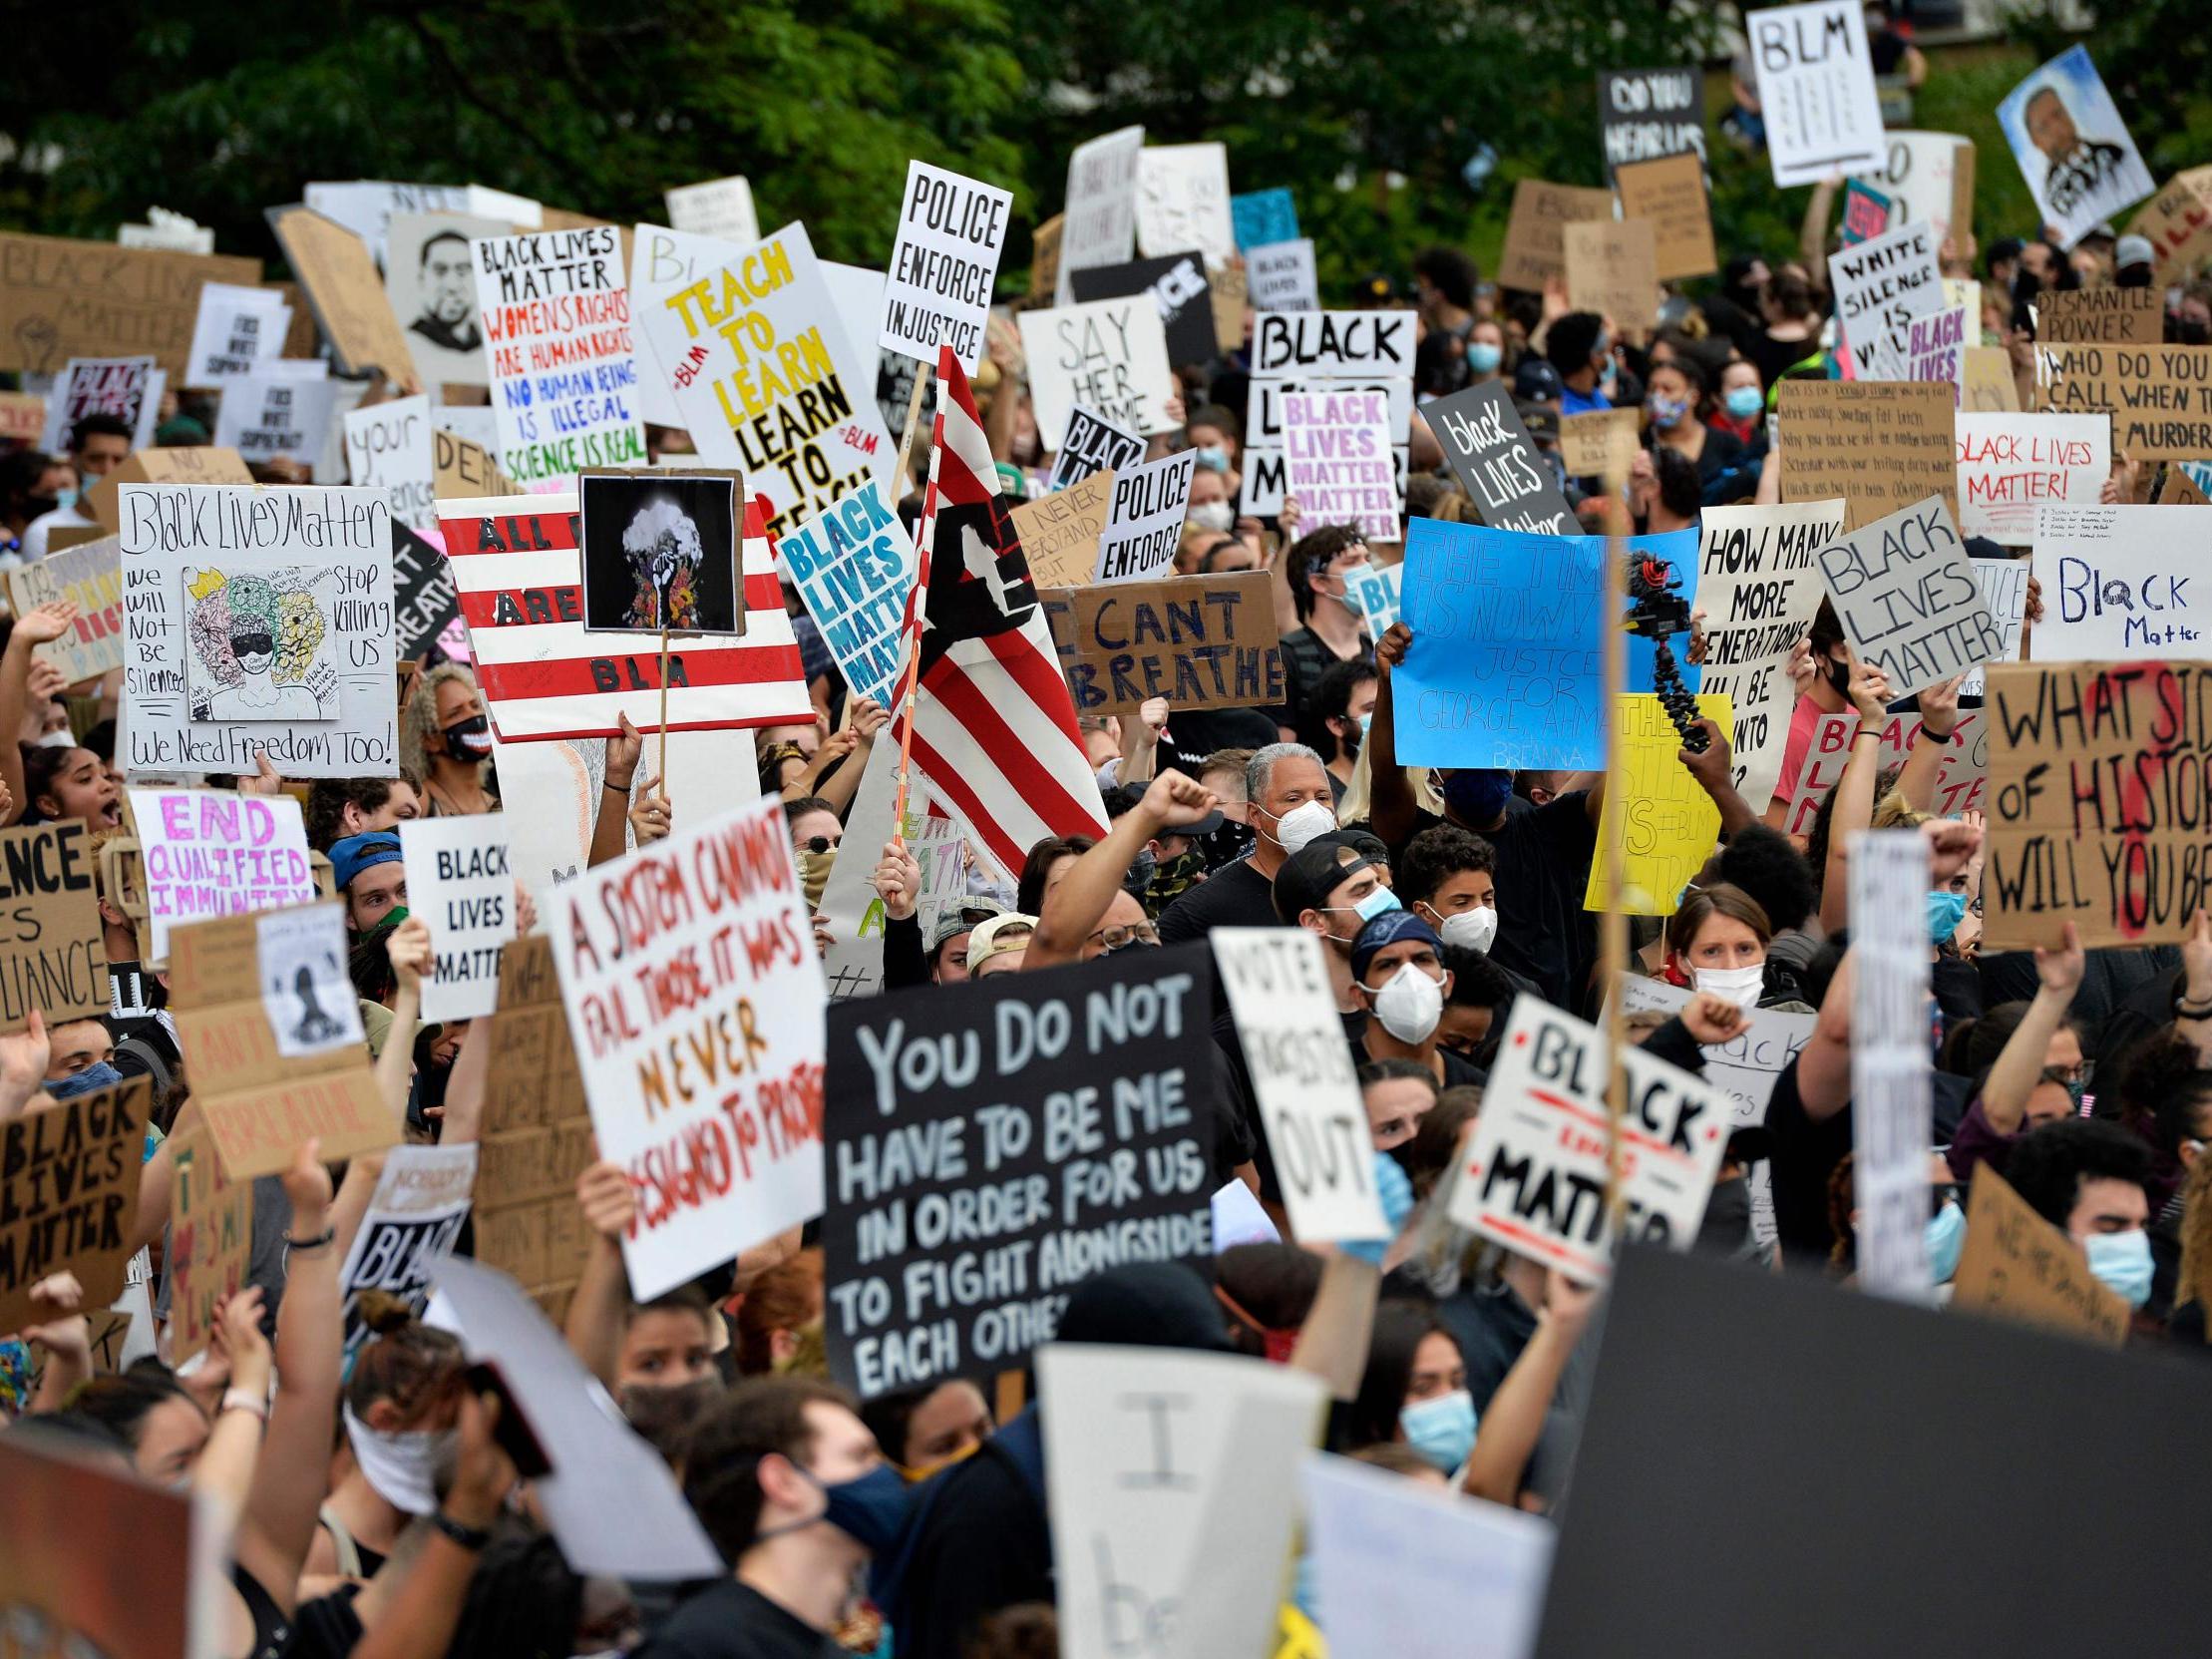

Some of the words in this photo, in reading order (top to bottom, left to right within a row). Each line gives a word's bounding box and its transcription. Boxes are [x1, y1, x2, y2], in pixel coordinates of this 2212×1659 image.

[1760, 14, 1852, 72] BLM
[909, 174, 1004, 249] POLICE
[481, 235, 545, 274] BLACK
[554, 227, 614, 261] LIVES
[896, 241, 992, 308] ENFORCE
[1259, 255, 1300, 272] BLACK
[1842, 234, 1928, 280] WHITE
[501, 259, 611, 303] MATTER
[574, 287, 630, 327] RIGHTS
[665, 239, 794, 338] TEACH
[1259, 279, 1297, 296] LIVES
[1844, 265, 1932, 318] SILENCE
[2039, 284, 2156, 315] DISMANTLE
[718, 310, 775, 367] TO
[886, 299, 980, 360] INJUSTICE
[1057, 306, 1133, 370] SAY
[1261, 314, 1402, 370] BLACK
[1884, 302, 1912, 329] IS
[1910, 308, 1965, 357] BLACK
[2047, 313, 2136, 342] POWER
[494, 345, 525, 378] ARE
[532, 335, 595, 373] HUMAN
[589, 325, 633, 357] RIGHTS
[713, 326, 835, 428] LEARN
[2046, 349, 2103, 377] WHO
[2117, 352, 2150, 379] DO
[2161, 353, 2209, 381] YOU
[504, 378, 533, 410] NO
[536, 368, 591, 402] HUMAN
[595, 359, 637, 390] BEING
[1072, 363, 1136, 403] HER
[1285, 395, 1383, 426] BLACK
[2048, 381, 2114, 407] CALL
[2120, 385, 2189, 411] WHEN
[517, 409, 539, 441] IS
[551, 395, 629, 432] ILLEGAL
[734, 373, 853, 473] LEARN
[1064, 413, 1140, 473] BLACK
[1289, 428, 1375, 459] LIVES
[1442, 399, 1518, 455] black
[351, 415, 418, 481] your
[505, 439, 578, 482] SCIENCE
[581, 433, 598, 467] IS
[605, 426, 646, 462] REAL
[778, 443, 831, 500] TO
[1291, 460, 1390, 486] MATTER
[2031, 436, 2092, 466] LIVES
[1112, 459, 1191, 526] POLICE
[1296, 487, 1392, 512] MATTER
[1471, 444, 1542, 509] LIVES
[1969, 469, 2069, 505] MATTER!
[122, 490, 208, 554] Black
[217, 489, 279, 550] Lives
[282, 495, 391, 550] Matter
[479, 517, 553, 553] ALL
[781, 481, 895, 584] BLACK
[1031, 484, 1103, 531] NEVER
[1034, 557, 1065, 582] BUT
[1102, 521, 1182, 580] ENFORCE
[1409, 530, 1501, 587] THE
[1704, 527, 1768, 575] HOW
[1772, 521, 1840, 572] MANY
[1818, 507, 1956, 596] BLACK
[333, 563, 380, 596] Stop
[496, 588, 581, 626] ARE
[803, 535, 903, 626] LIVES
[1730, 580, 1795, 622] MORE
[1845, 561, 1977, 645] LIVES
[130, 619, 178, 639] Not
[1094, 591, 1242, 649] CANT
[1411, 582, 1464, 639] IS
[2124, 615, 2202, 648] Matter
[139, 640, 167, 662] Be
[1702, 621, 1810, 665] ENERATIONS
[1864, 610, 2006, 689] MATTER
[590, 653, 690, 693] BLM
[1068, 643, 1287, 709] BREATHE
[1506, 674, 1579, 707] FOR
[1746, 664, 1776, 707] BE
[1418, 690, 1528, 736] GEORGE,
[1734, 713, 1768, 755] INTO
[1998, 670, 2144, 750] WHAT
[132, 728, 168, 760] We
[177, 725, 228, 764] Need
[229, 723, 331, 762] Freedom
[343, 717, 392, 764] Too!
[1999, 762, 2051, 823] OF
[160, 796, 275, 847] END
[148, 846, 307, 888] QUALIFIED
[438, 844, 509, 881] BLACK
[569, 896, 600, 979] A
[598, 852, 696, 961] SYSTEM
[692, 802, 796, 915] CANNOT
[1995, 835, 2091, 913] WILL
[2100, 841, 2174, 930] YOU
[151, 884, 310, 916] IMMUNITY
[447, 897, 505, 931] LIVES
[581, 993, 641, 1059] FAIL
[635, 944, 713, 1026] THOSE
[709, 922, 736, 989] IT
[739, 906, 804, 981] WAS
[1222, 938, 1319, 994] VOTE
[634, 998, 768, 1122] NEVER
[856, 1018, 981, 1117] YOU
[994, 995, 1072, 1075] DO
[1085, 972, 1194, 1054] NOT
[1242, 1022, 1353, 1088] RACISTS
[1531, 1019, 1704, 1155] BLCK
[4, 1084, 137, 1179] BLACK
[836, 1115, 968, 1205] HAVE
[974, 1103, 1033, 1171] TO
[1042, 1087, 1105, 1164] BE
[1111, 1067, 1192, 1142] ME
[1274, 1109, 1369, 1197] OUT
[0, 1140, 125, 1230] LIVES
[855, 1198, 907, 1266] IN
[914, 1173, 1053, 1250] ORDER
[1060, 1148, 1143, 1226] FOR
[1144, 1138, 1208, 1196] US
[830, 1277, 894, 1337] TO
[902, 1238, 1034, 1322] FIGHT
[1037, 1208, 1214, 1291] ALONGSIDE
[852, 1318, 960, 1399] EACH
[1114, 1393, 1197, 1488] I
